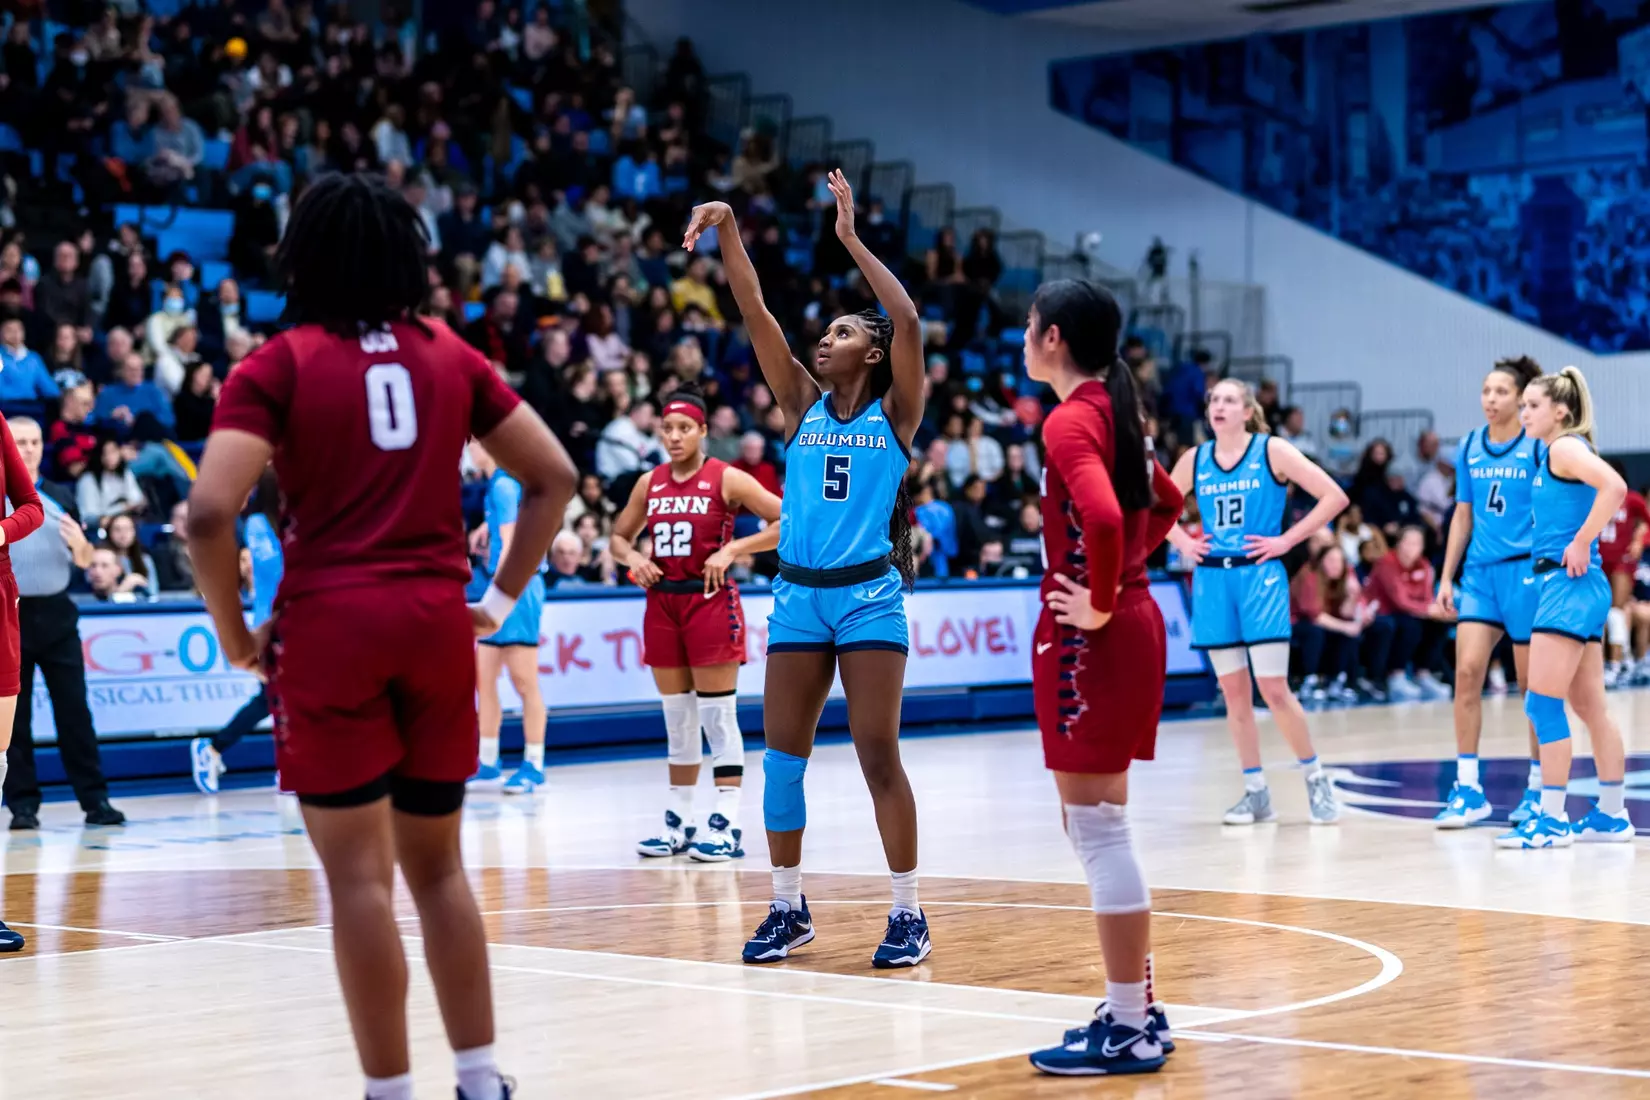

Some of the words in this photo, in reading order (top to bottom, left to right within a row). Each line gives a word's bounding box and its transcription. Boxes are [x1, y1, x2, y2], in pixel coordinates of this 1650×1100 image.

[364, 362, 418, 451] 0
[799, 433, 888, 449] COLUMBIA
[822, 454, 852, 502] 5
[647, 495, 712, 517] PENN
[1214, 494, 1245, 531] 12
[1485, 481, 1507, 517] 4
[653, 521, 693, 557] 22
[912, 616, 1018, 656] LOVE!
